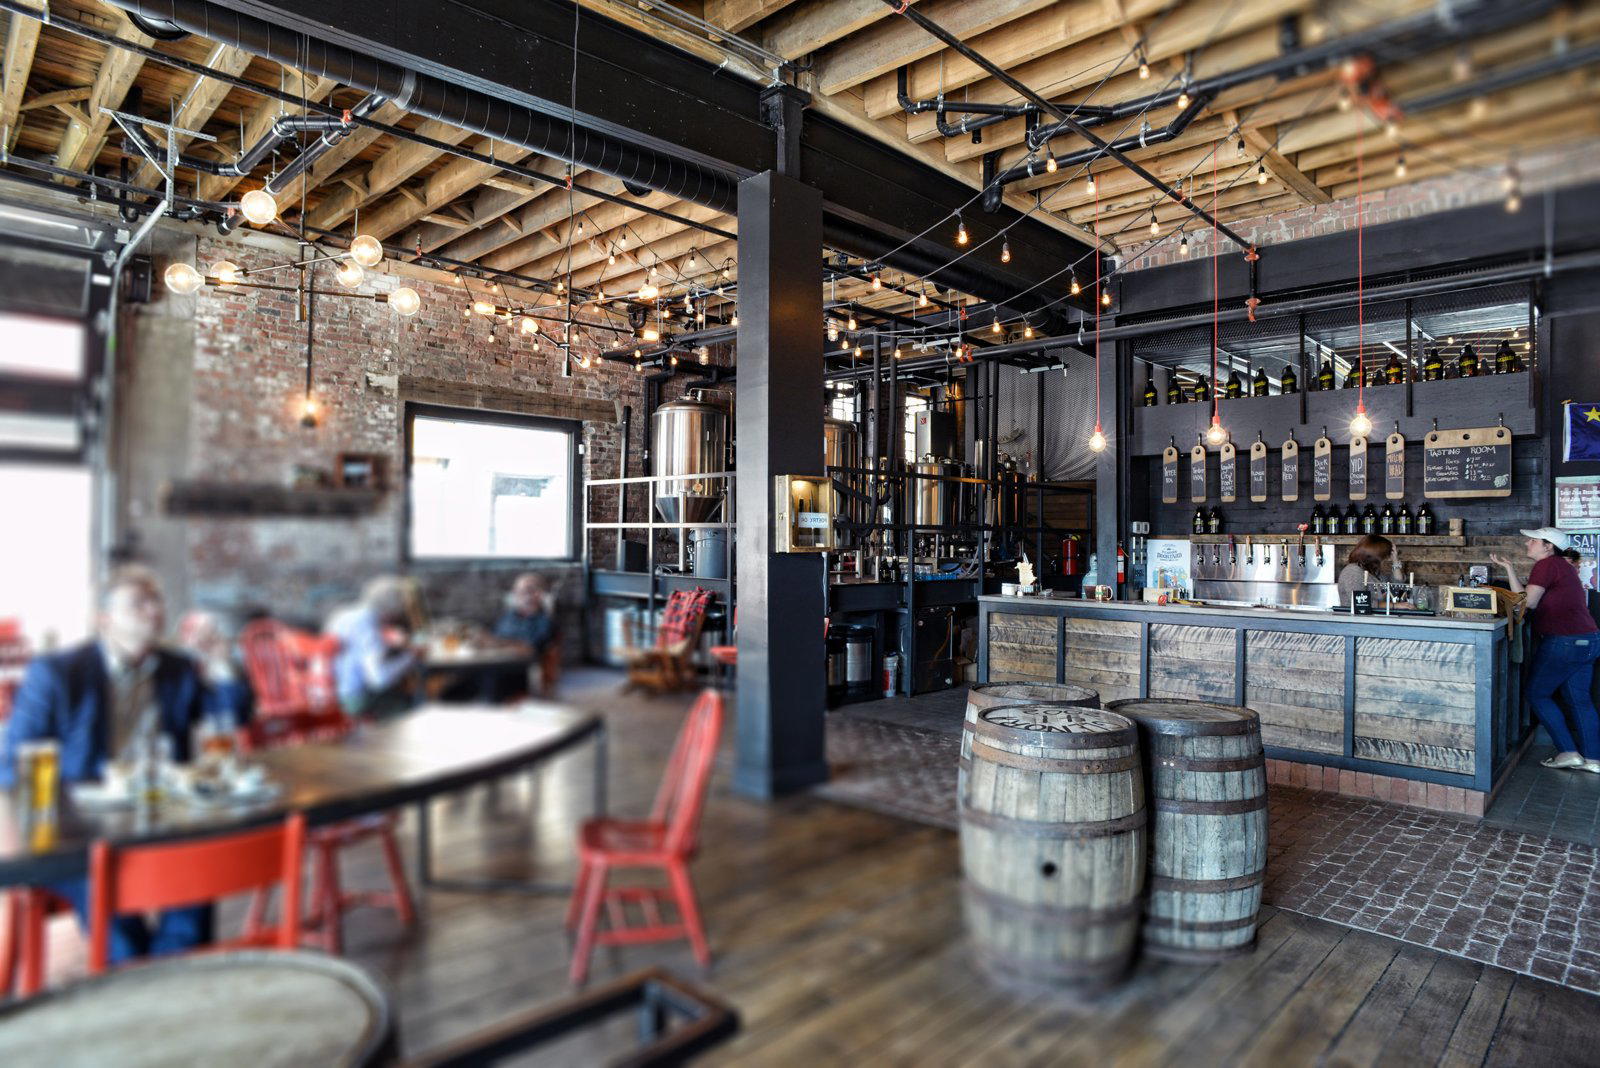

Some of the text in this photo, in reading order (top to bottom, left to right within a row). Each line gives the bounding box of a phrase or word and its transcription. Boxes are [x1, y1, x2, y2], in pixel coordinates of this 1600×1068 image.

[1428, 446, 1497, 457] TASTING ROOM
[1568, 534, 1594, 548] LSA!
